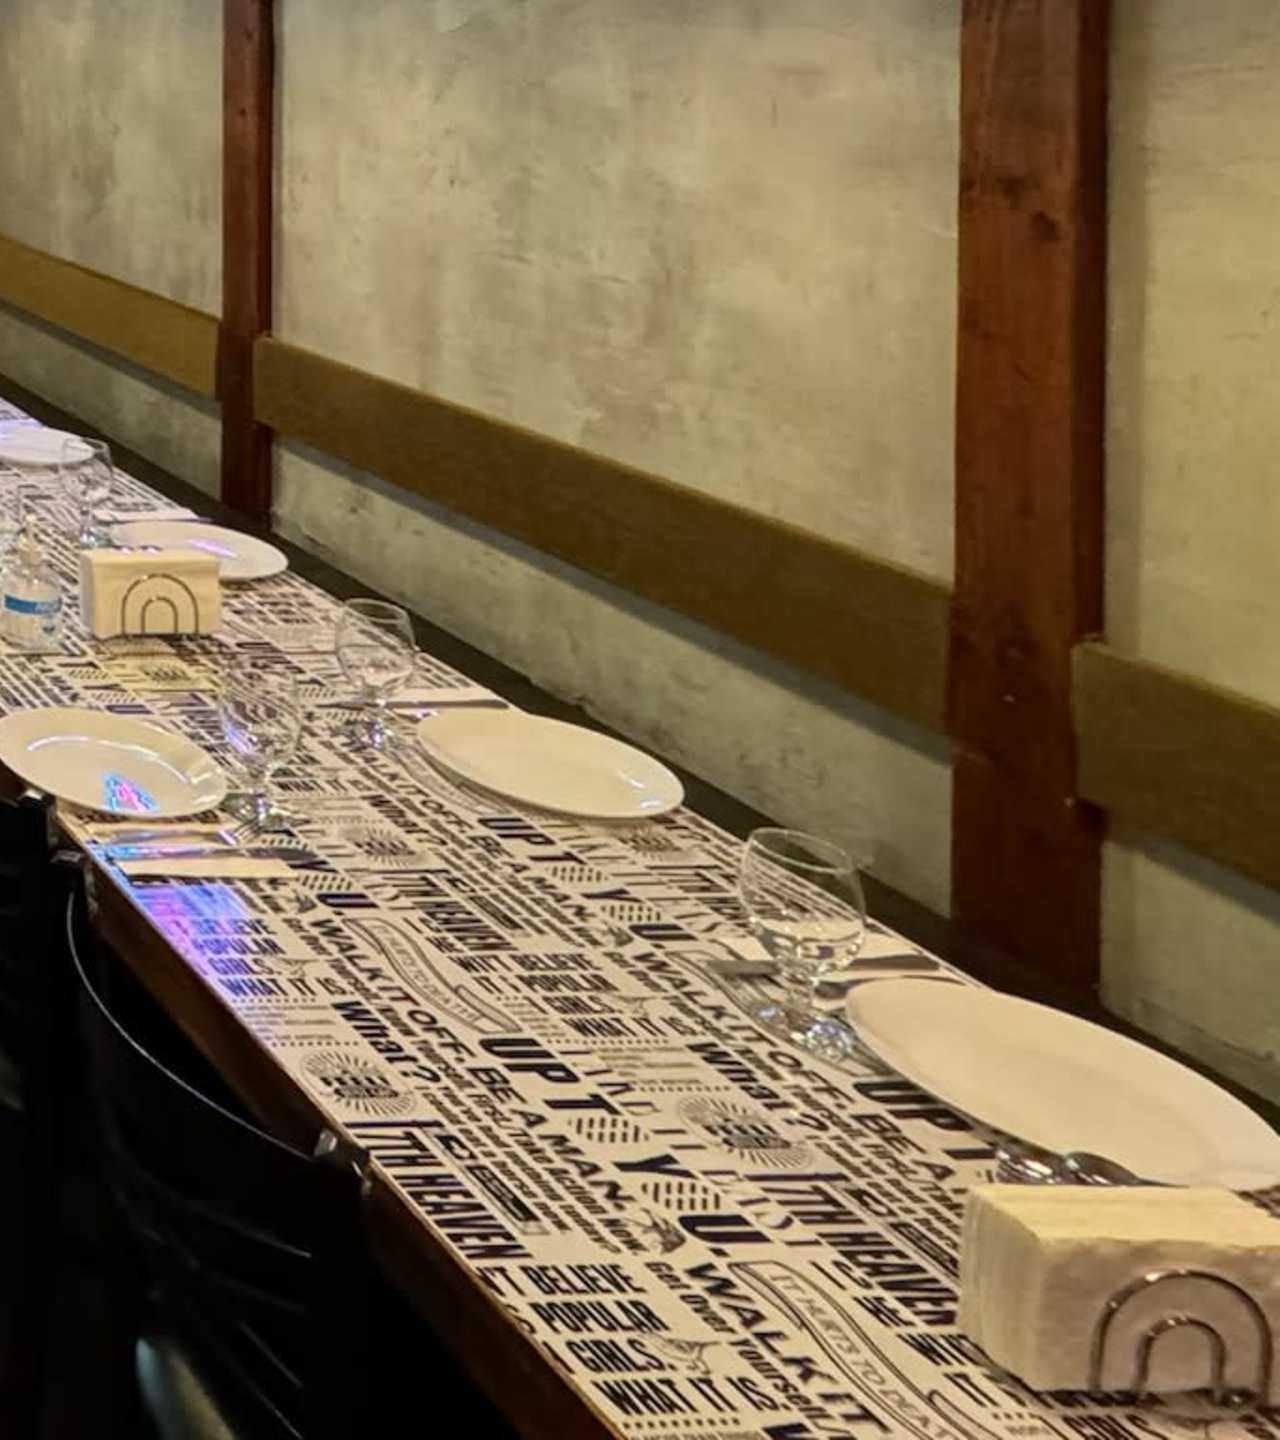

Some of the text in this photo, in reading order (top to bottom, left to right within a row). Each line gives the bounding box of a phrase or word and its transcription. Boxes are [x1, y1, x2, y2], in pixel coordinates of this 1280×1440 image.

[479, 818, 554, 845] UP
[220, 978, 287, 996] WHAT
[288, 978, 315, 995] IT
[563, 1018, 635, 1036] WHAT
[618, 953, 738, 1019] WALK
[768, 1051, 854, 1109] OFF.
[311, 919, 391, 981] WALK
[378, 986, 420, 1006] IT
[408, 1010, 475, 1062] OFF.
[510, 1109, 547, 1128] A
[540, 1135, 645, 1211] MAN.
[479, 1037, 582, 1084] UP
[357, 1132, 442, 1167] 7TH
[397, 1174, 528, 1258] HEAVEN
[545, 1168, 606, 1214] Action
[599, 1218, 647, 1254] Now.
[764, 1186, 863, 1224] 7TH
[521, 1265, 644, 1294] BELIEVE
[645, 1262, 690, 1289] Get
[680, 1294, 736, 1333] Over
[531, 1301, 667, 1332] POPULAR
[567, 1339, 674, 1372] GIRLS.
[687, 1264, 890, 1432] WALK IT
[594, 1377, 790, 1414] WHAT IT IS.
